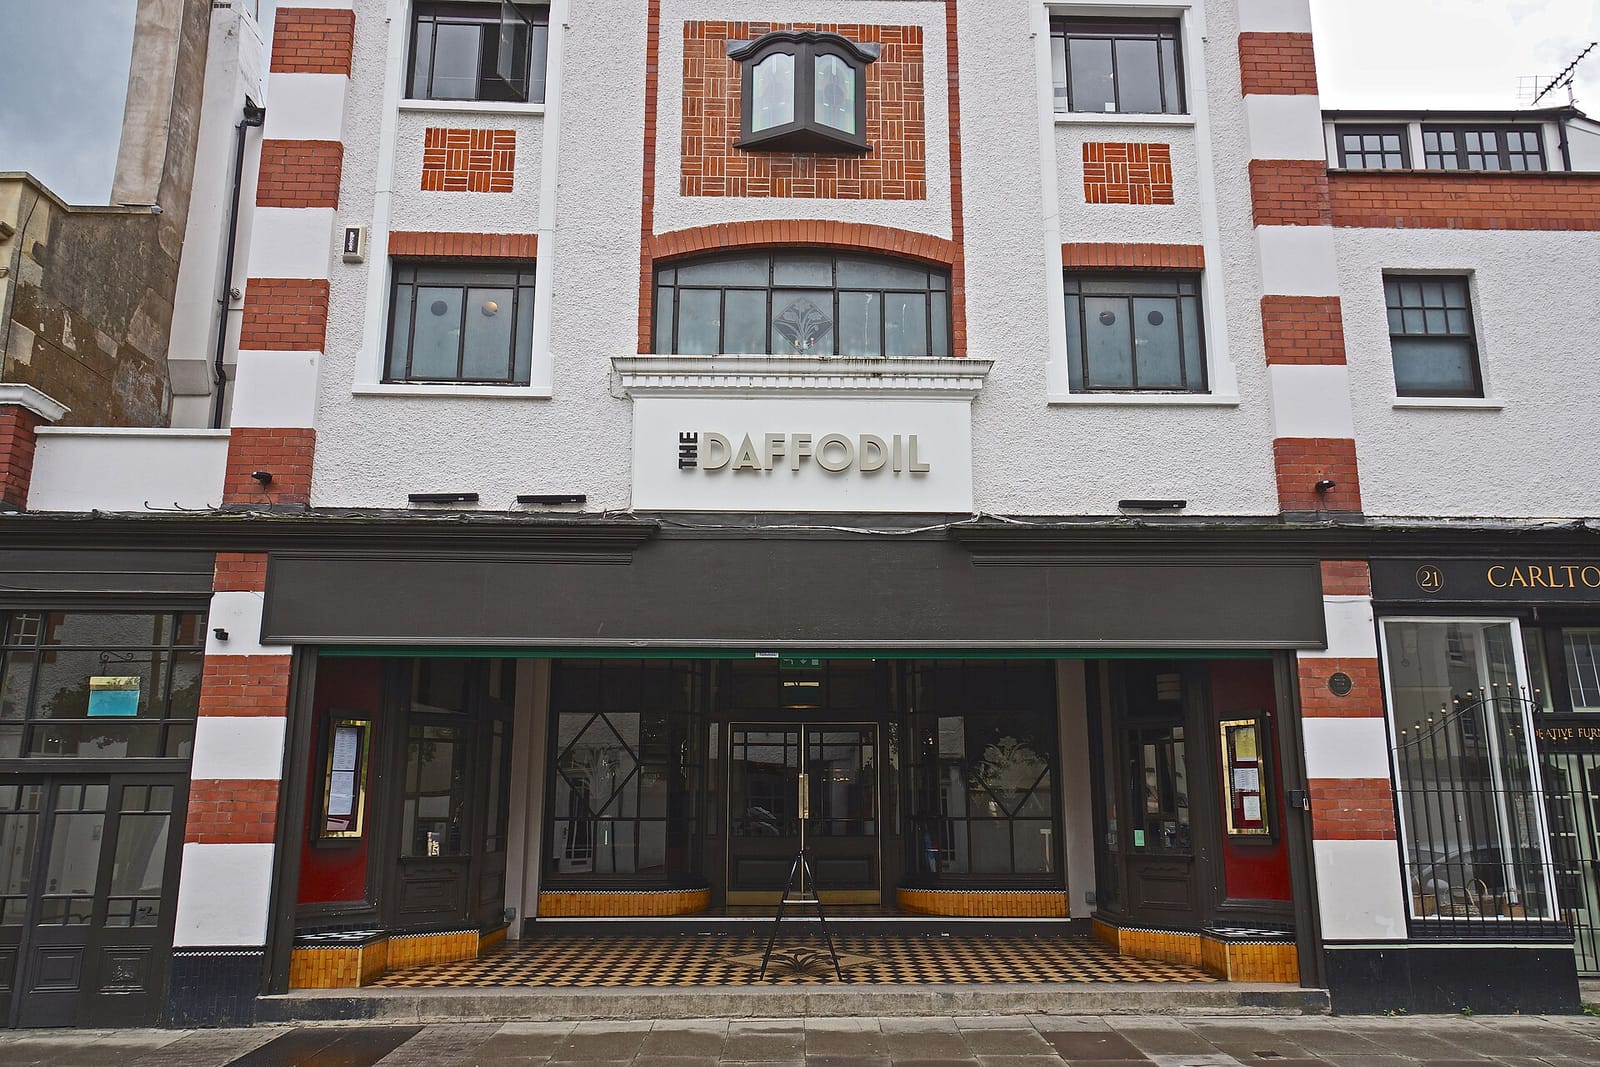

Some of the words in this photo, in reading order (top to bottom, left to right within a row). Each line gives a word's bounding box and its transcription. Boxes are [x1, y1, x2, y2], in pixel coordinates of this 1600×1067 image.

[678, 431, 698, 470] THE
[703, 432, 930, 472] DAFFODIL
[1421, 570, 1439, 587] 21
[1487, 565, 1600, 588] CARLTO
